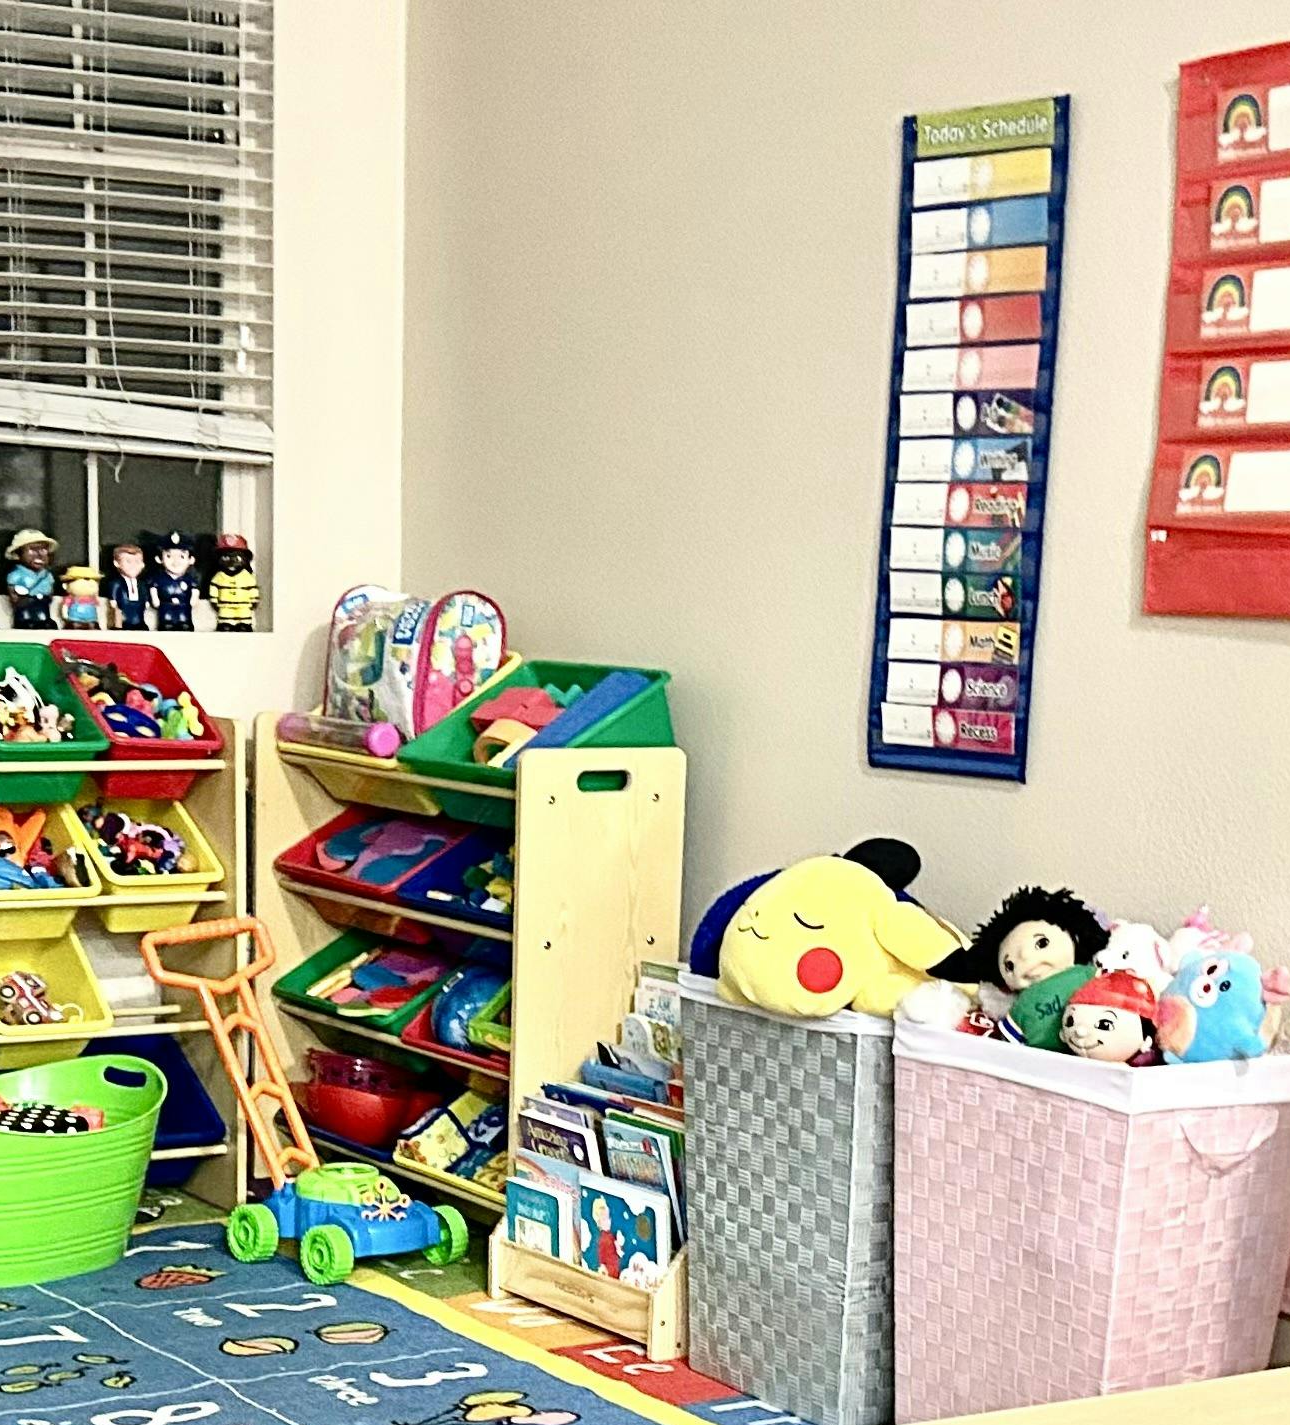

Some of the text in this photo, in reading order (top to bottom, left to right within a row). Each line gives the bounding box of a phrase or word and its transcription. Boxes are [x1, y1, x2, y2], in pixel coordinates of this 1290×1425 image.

[923, 115, 1049, 145] Today's Schedule
[965, 678, 1009, 698] Science
[960, 723, 998, 742] Recess
[1035, 993, 1063, 1021] Sad
[222, 1293, 338, 1318] 2
[368, 1361, 489, 1388] 3
